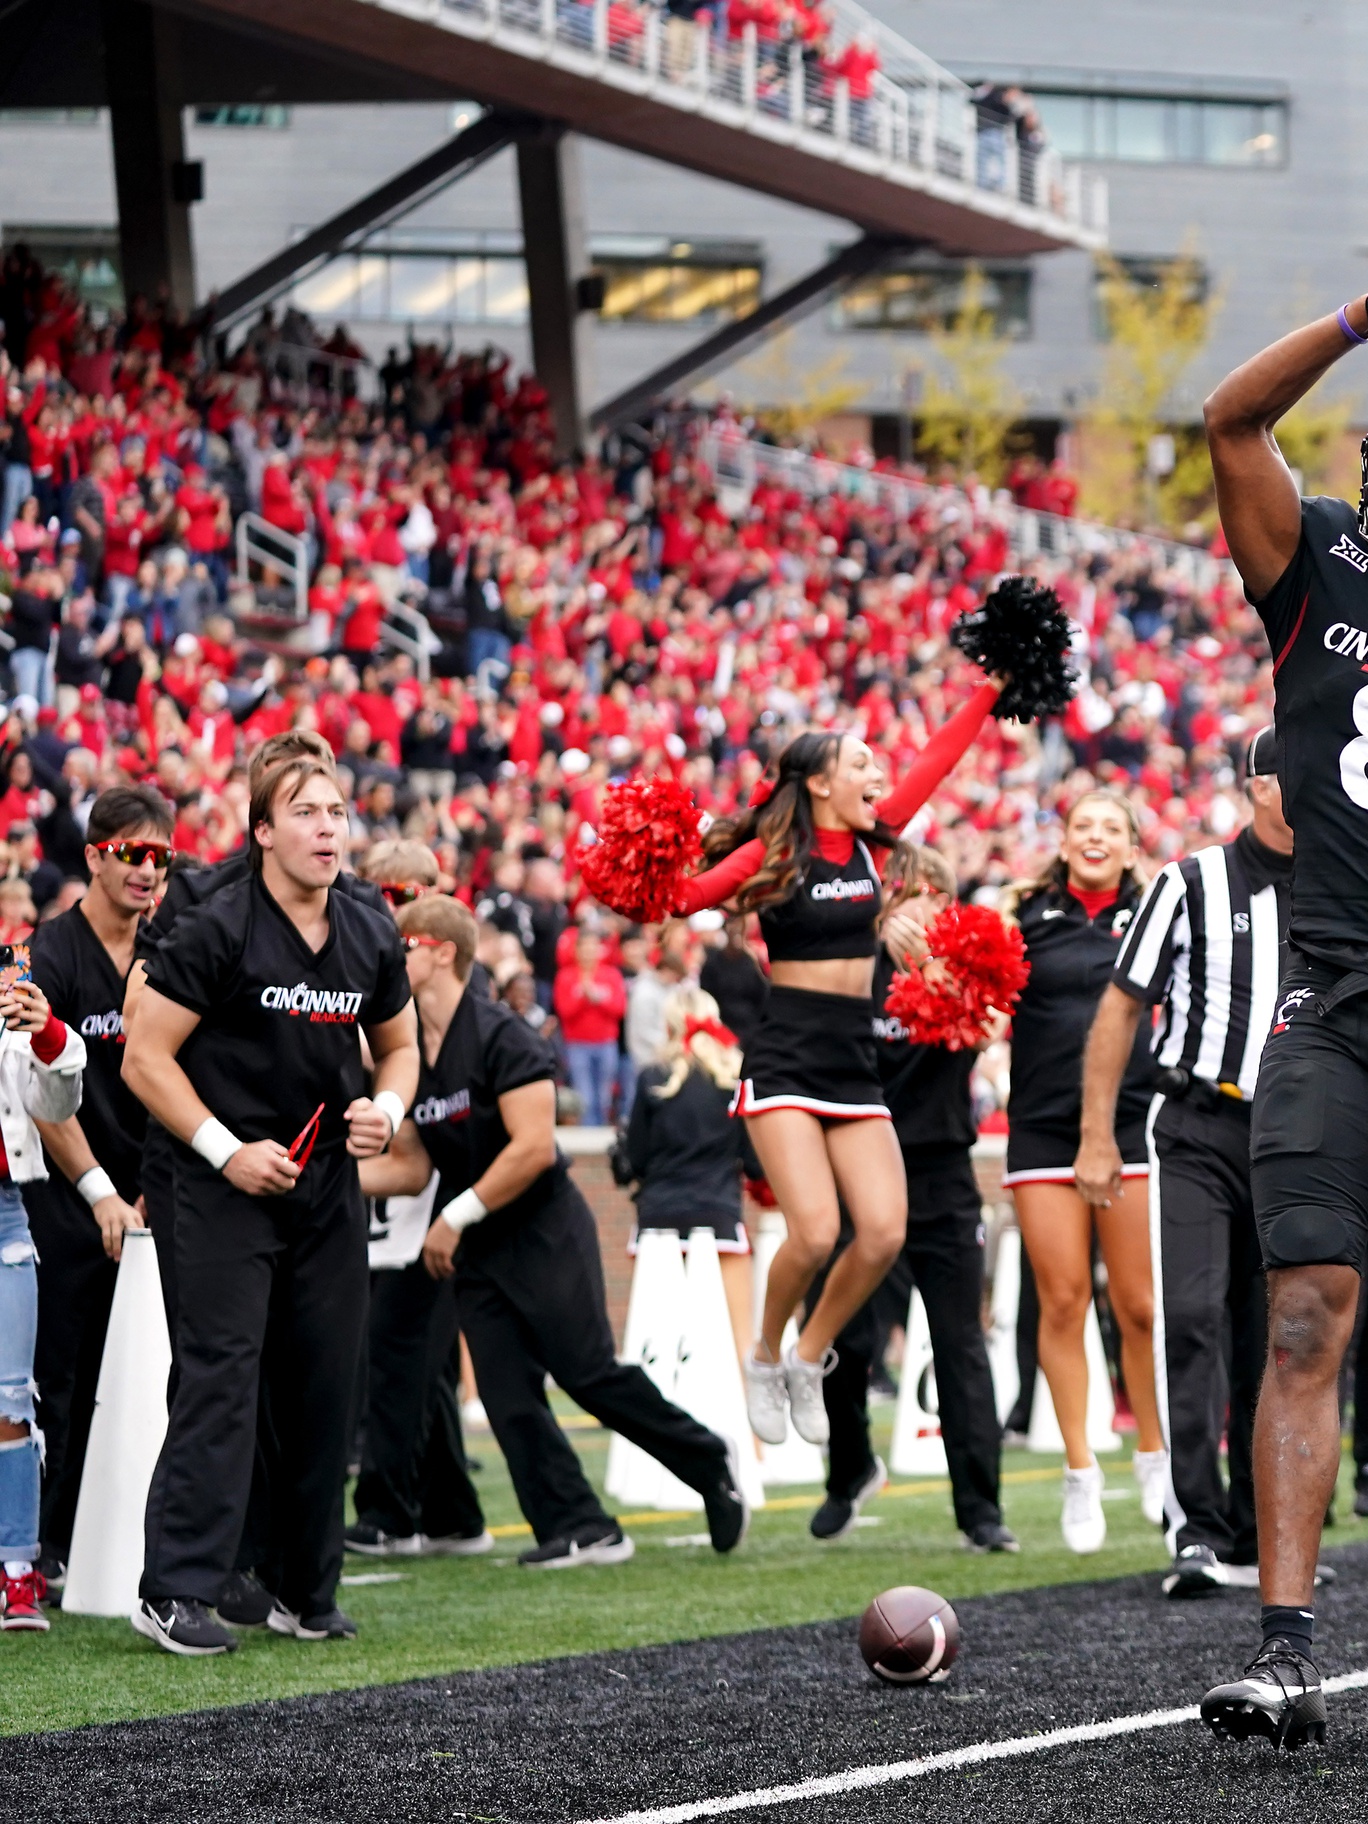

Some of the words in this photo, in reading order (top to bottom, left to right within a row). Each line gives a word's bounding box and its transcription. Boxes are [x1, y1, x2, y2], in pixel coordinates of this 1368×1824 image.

[811, 877, 874, 900] CINCINNATI
[1233, 912, 1250, 933] S
[260, 982, 362, 1015] CINCINNATI
[309, 1012, 356, 1023] BEARCATS
